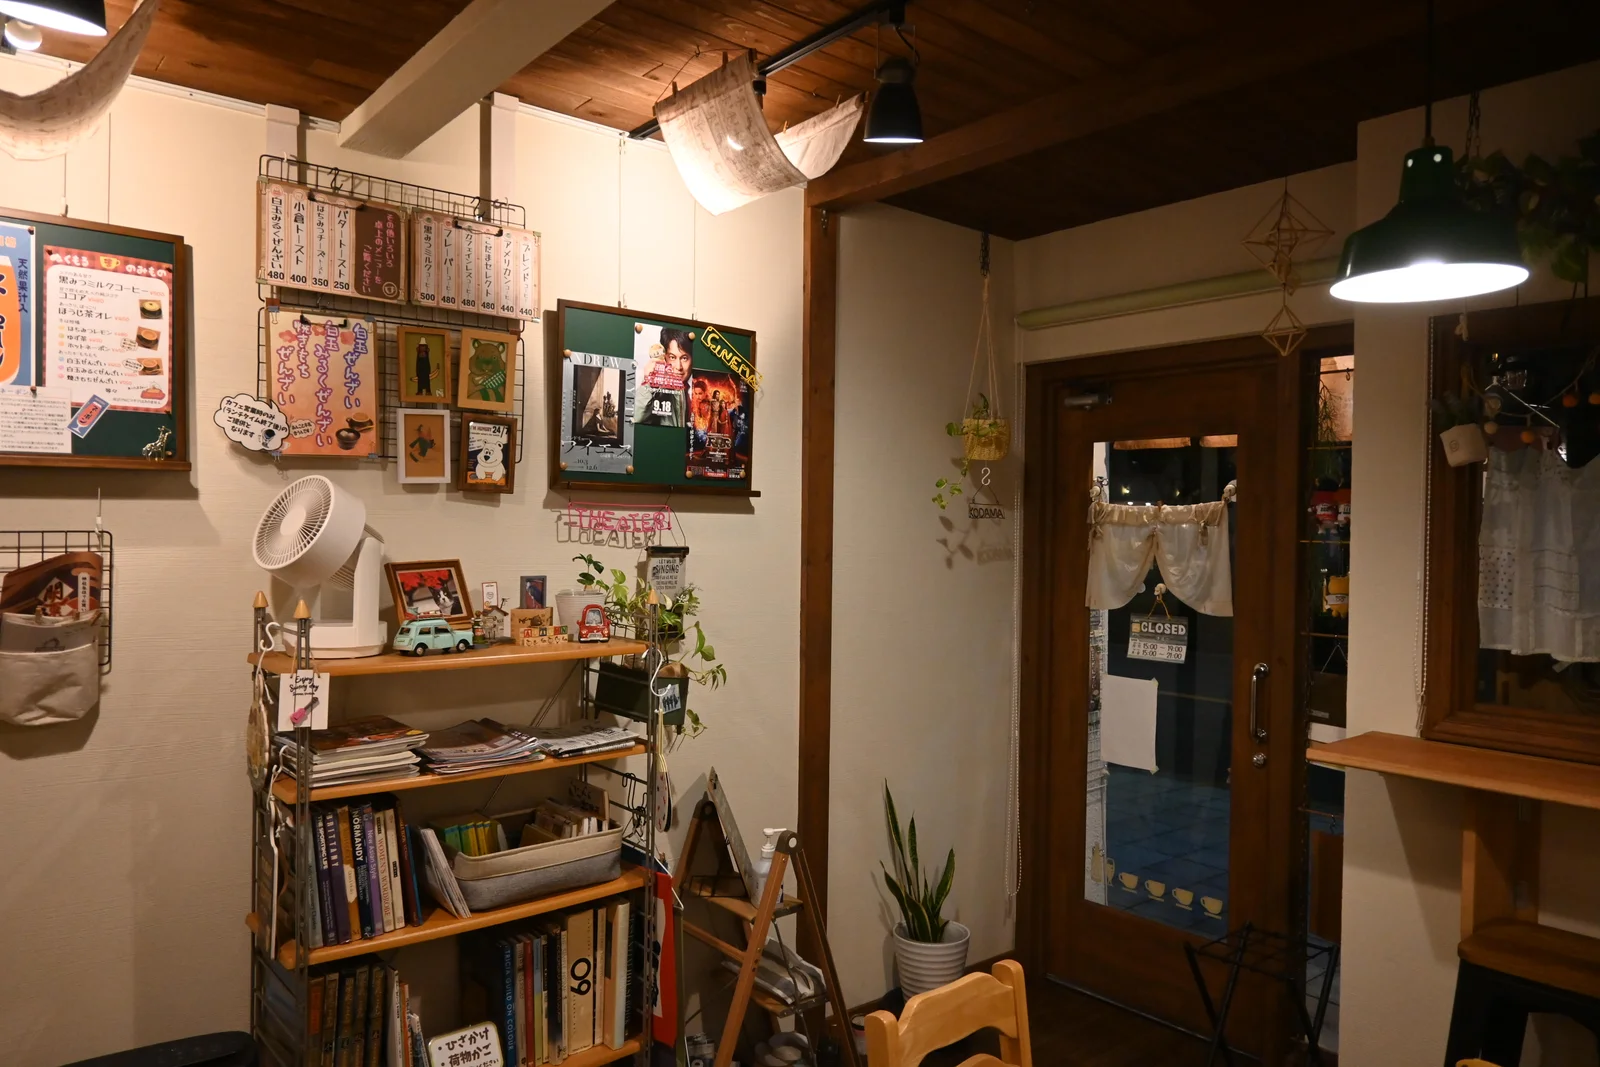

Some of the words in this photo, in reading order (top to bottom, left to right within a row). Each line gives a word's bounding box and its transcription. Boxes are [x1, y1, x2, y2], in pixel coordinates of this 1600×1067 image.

[271, 197, 283, 269] 白玉みるくぜんざい
[294, 202, 305, 266] 小倉トースト
[337, 209, 349, 278] バタートースト
[423, 225, 433, 292] 黒みつミルクコーヒー
[125, 264, 167, 277] のみもの
[267, 270, 285, 280] 480
[290, 274, 307, 284] 400
[18, 258, 28, 313] 天然果汁入
[59, 275, 149, 295] 黒みつミルクコーヒー
[312, 277, 329, 287] 350
[333, 281, 350, 291] 250
[59, 291, 86, 301] ココア
[420, 292, 435, 301] 500
[441, 295, 456, 304] 480
[461, 299, 476, 307] 480
[481, 301, 495, 310] 480
[58, 307, 112, 320] ほうじ茶オレ
[501, 305, 514, 313] 440
[519, 308, 533, 316] 440
[324, 320, 340, 351] 白玉
[352, 323, 368, 354] 白玉
[293, 320, 312, 378] 焼きもち
[707, 333, 757, 388] CINEMA
[277, 346, 296, 405] ぜんざい
[343, 350, 362, 409] ぜんざい
[314, 344, 333, 447] みるくぜんざい
[653, 399, 672, 411] 9.18
[225, 399, 276, 421] カフェ営業時のみ
[230, 425, 255, 438] なります
[575, 507, 665, 531] THEATER
[969, 507, 1004, 519] KODAMA
[1141, 622, 1186, 635] CLOSED
[1142, 649, 1157, 657] 15:00
[1166, 652, 1182, 660] 21:00
[1143, 642, 1157, 650] 15:00
[325, 812, 340, 867] BRITTANY
[352, 809, 364, 861] NORMANDY
[368, 843, 376, 862] Asian
[379, 837, 387, 875] WOMEN'S
[370, 862, 378, 879] Style
[381, 876, 391, 916] WARDROBE
[506, 1003, 512, 1017] ON
[445, 1027, 489, 1051] ひざかけ
[448, 1042, 492, 1067] 荷物かご
